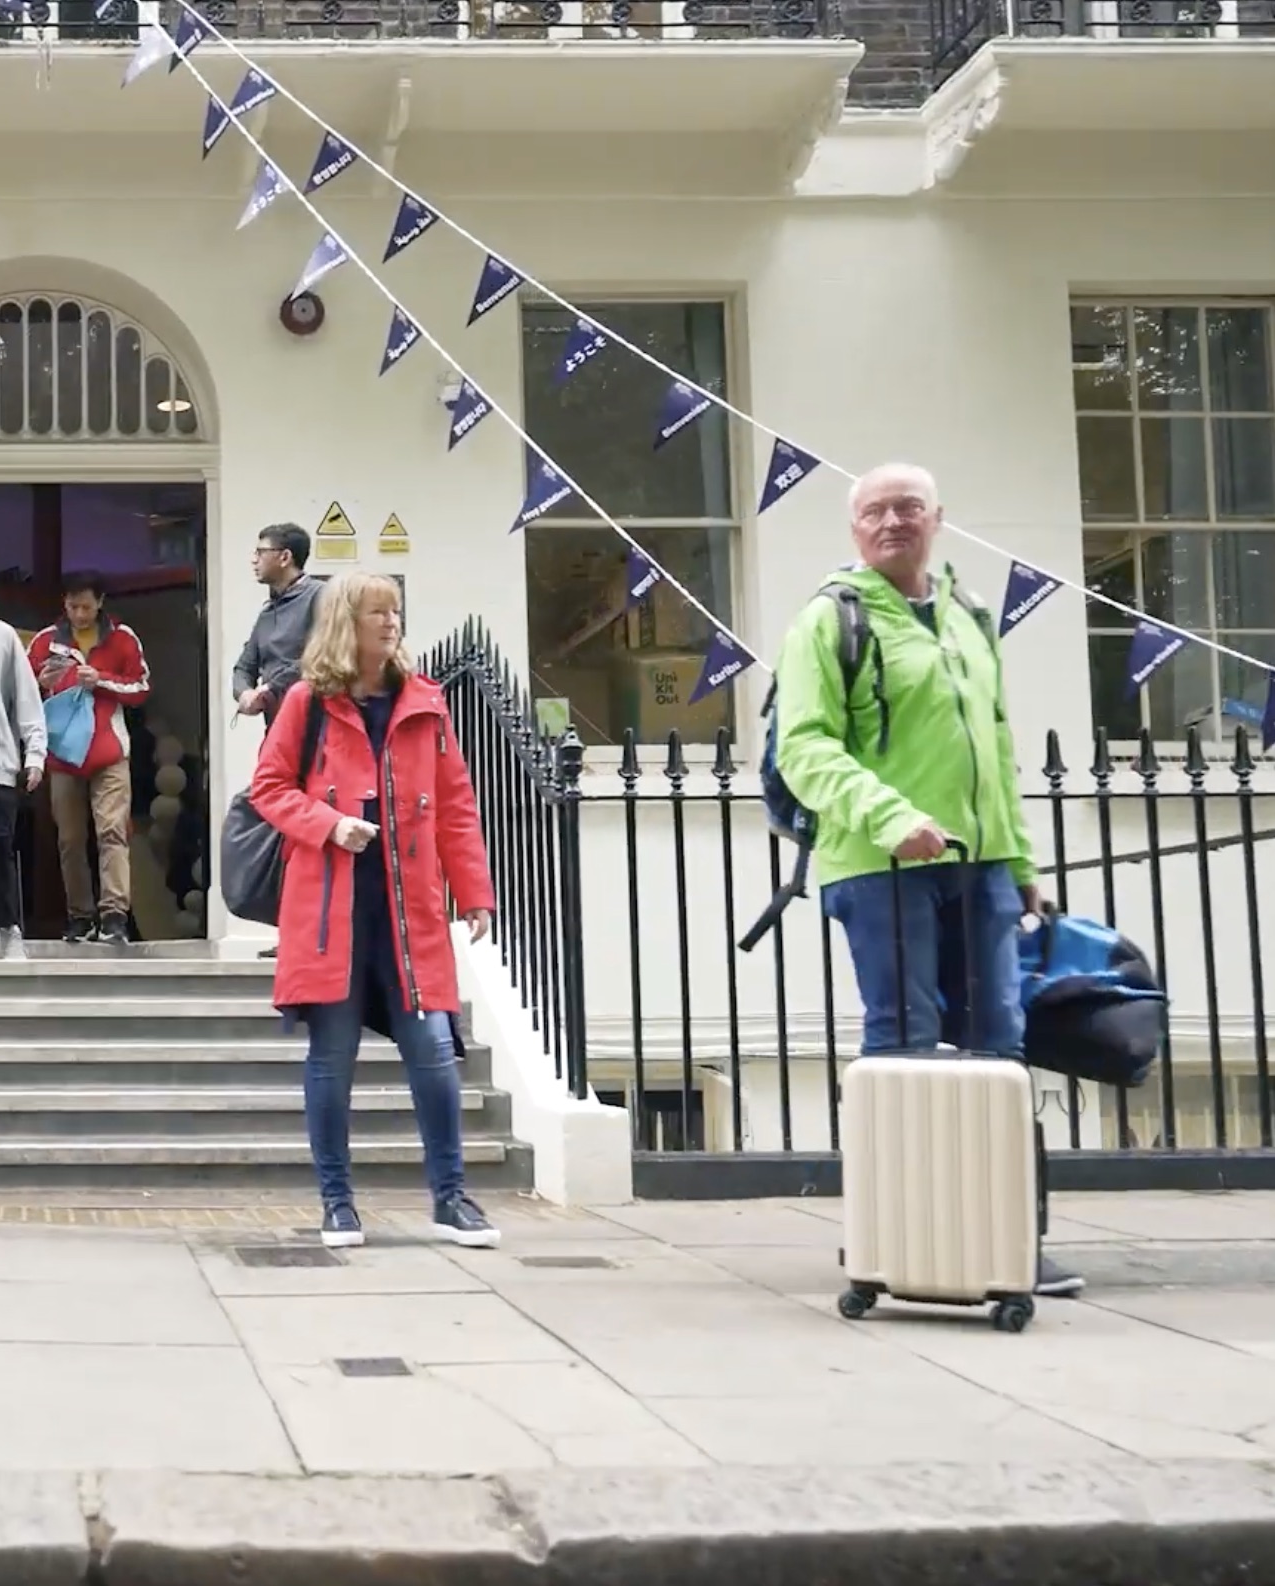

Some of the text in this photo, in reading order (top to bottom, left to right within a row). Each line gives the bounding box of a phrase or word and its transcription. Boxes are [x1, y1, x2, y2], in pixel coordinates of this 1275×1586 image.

[565, 335, 607, 372] ようこそ
[774, 463, 803, 489] 欢迎
[1006, 580, 1057, 622] Welcome
[655, 672, 677, 683] Uni
[708, 661, 742, 686] Karibu
[655, 684, 674, 694] Kit
[655, 694, 679, 705] Out
